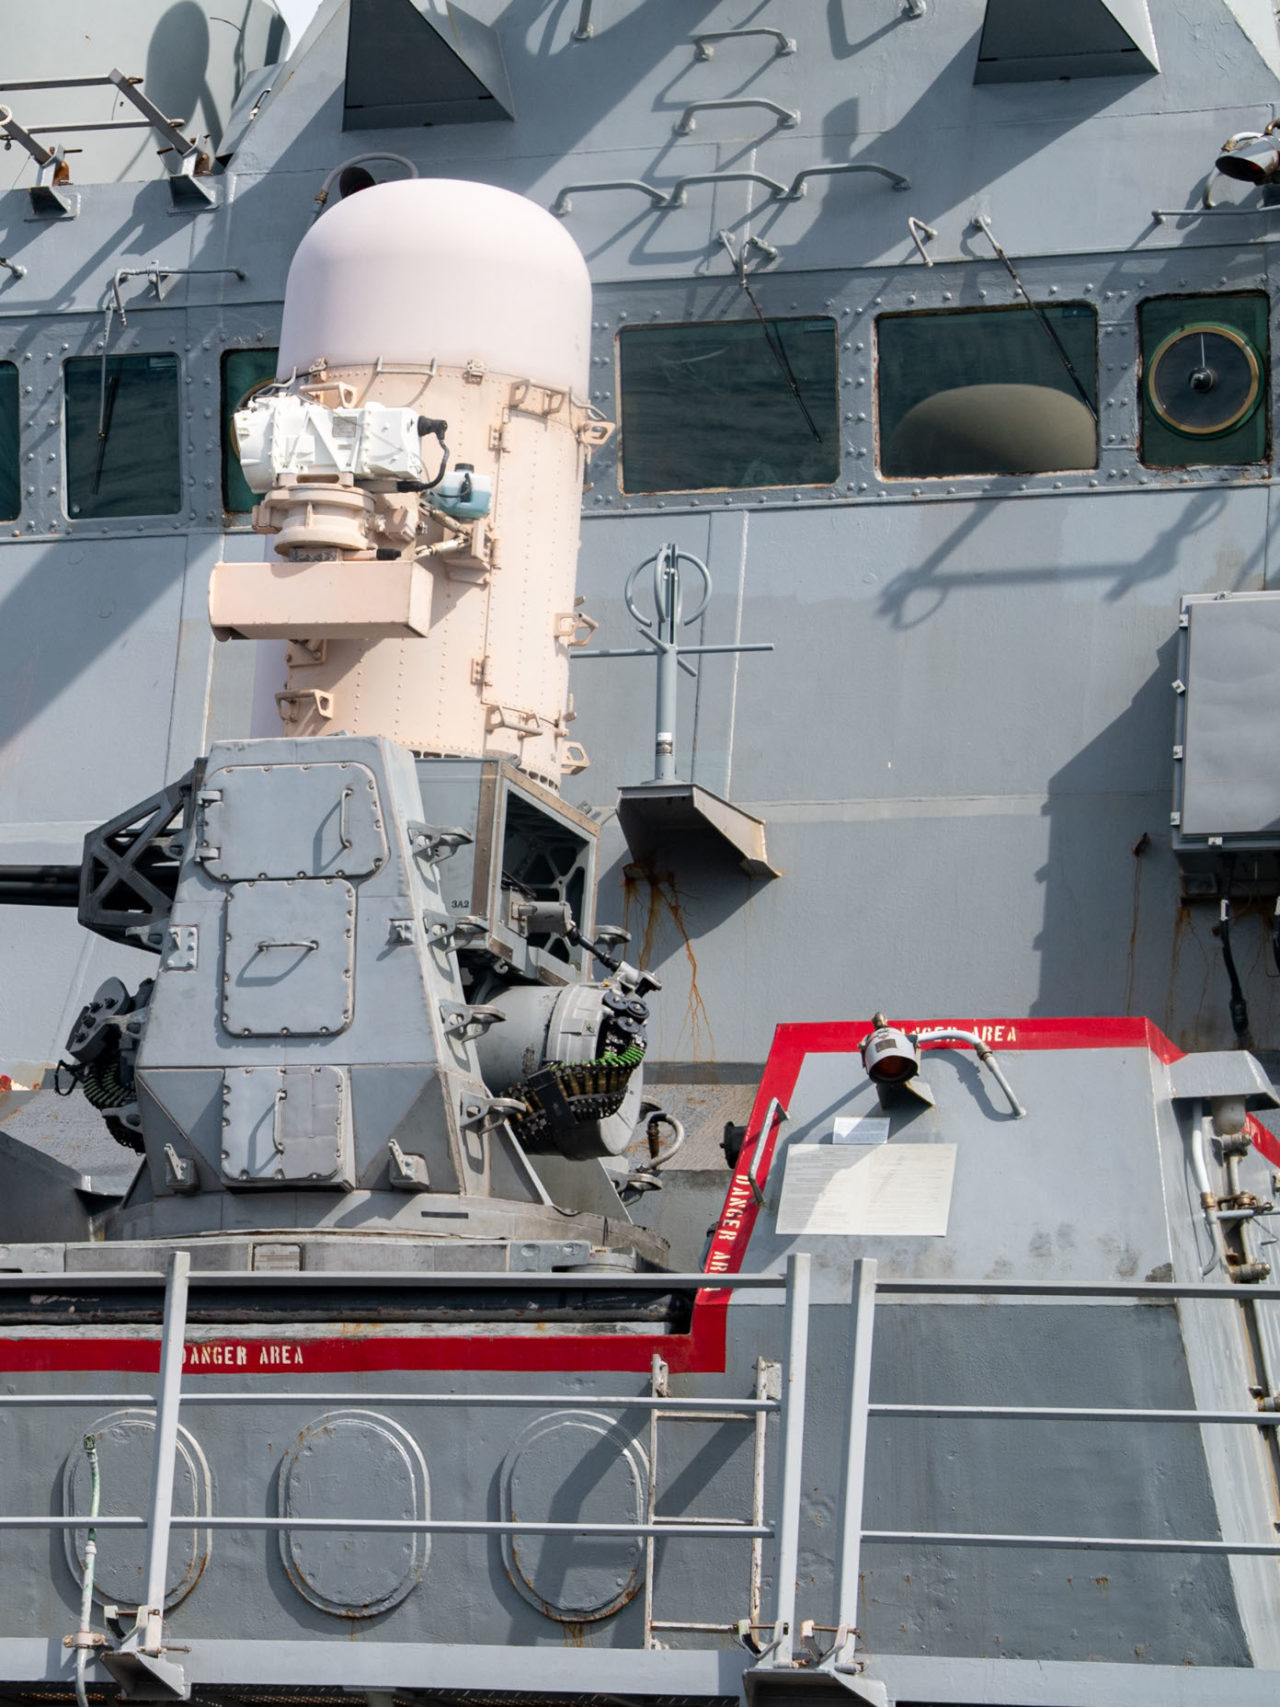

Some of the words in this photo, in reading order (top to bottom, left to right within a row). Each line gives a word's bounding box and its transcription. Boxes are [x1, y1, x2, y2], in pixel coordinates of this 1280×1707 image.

[451, 900, 470, 909] 3A2
[718, 1174, 751, 1240] DANGER
[259, 1345, 304, 1365] AREA
